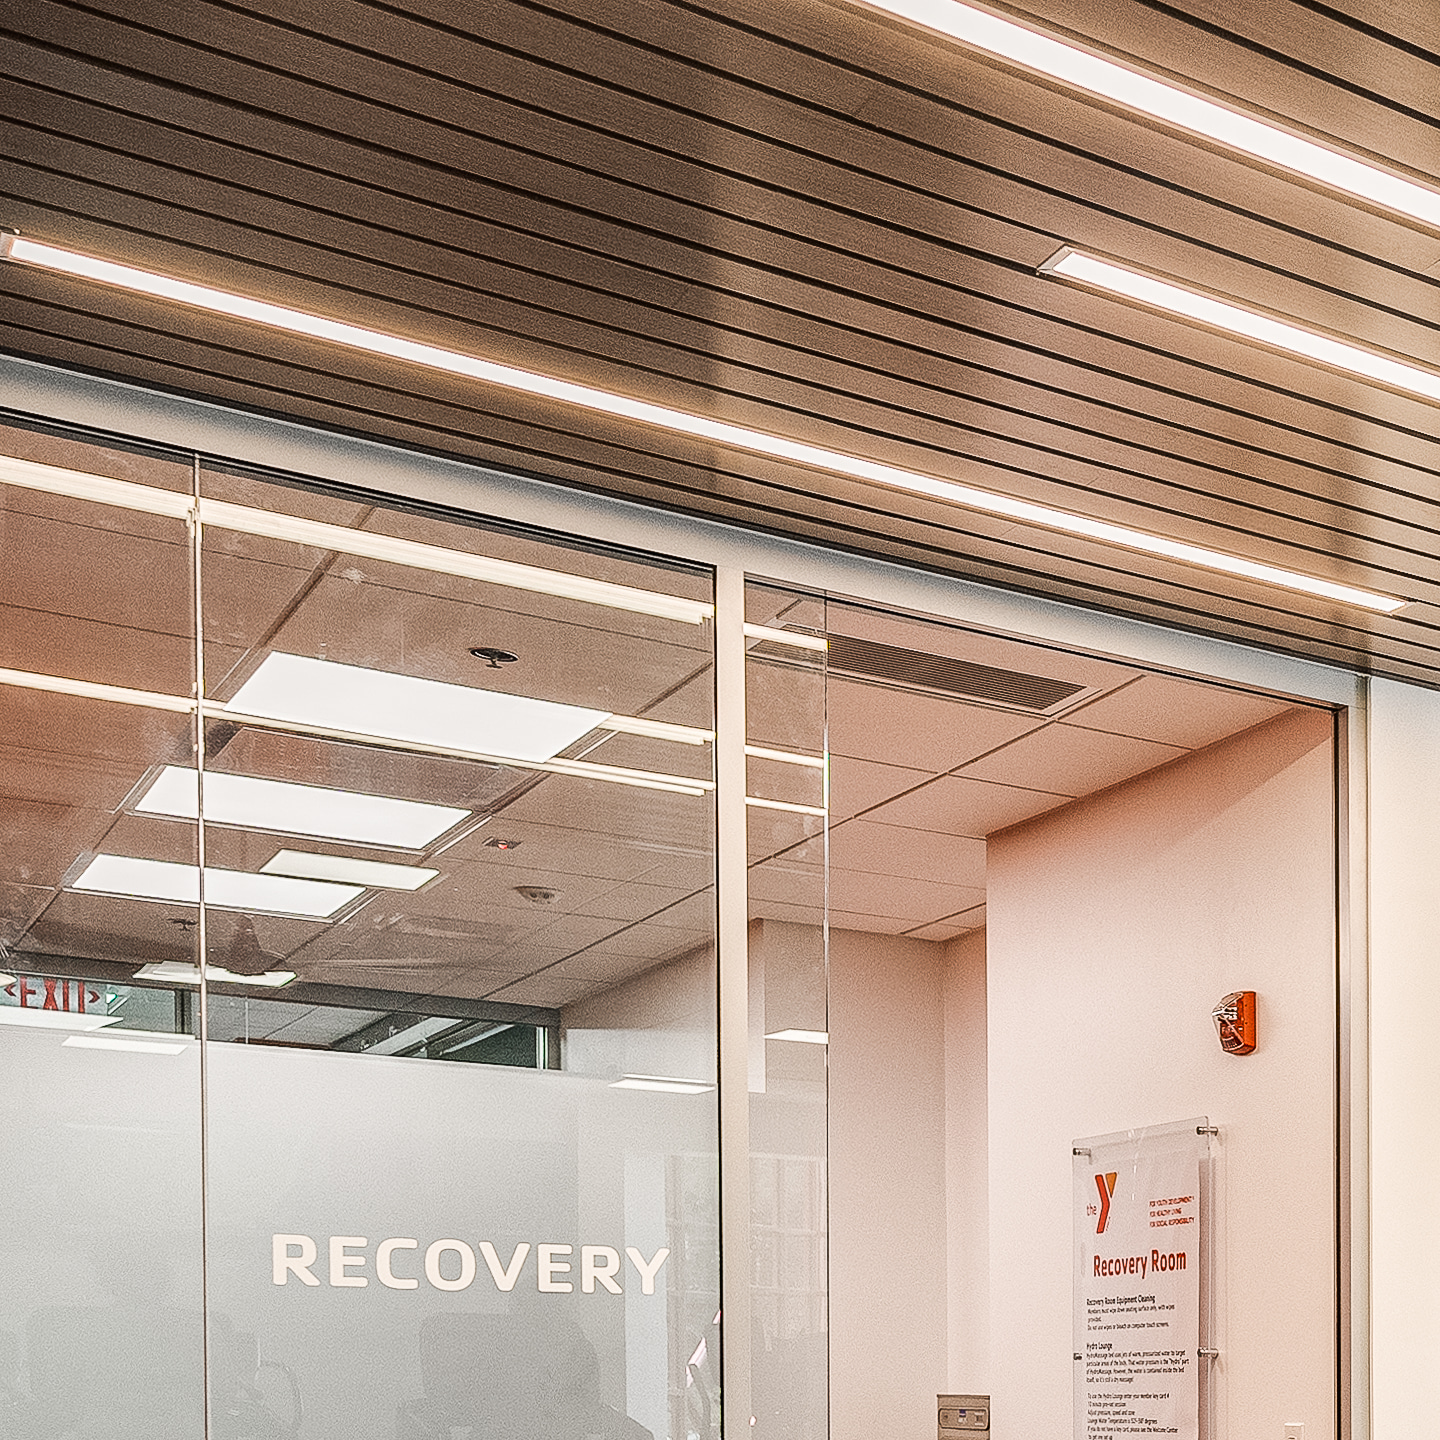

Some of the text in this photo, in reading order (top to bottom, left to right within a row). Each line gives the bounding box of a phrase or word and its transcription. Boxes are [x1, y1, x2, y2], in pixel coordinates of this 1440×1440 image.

[272, 1233, 671, 1296] RECOVERY
[1093, 1249, 1187, 1280] Recovery Room
